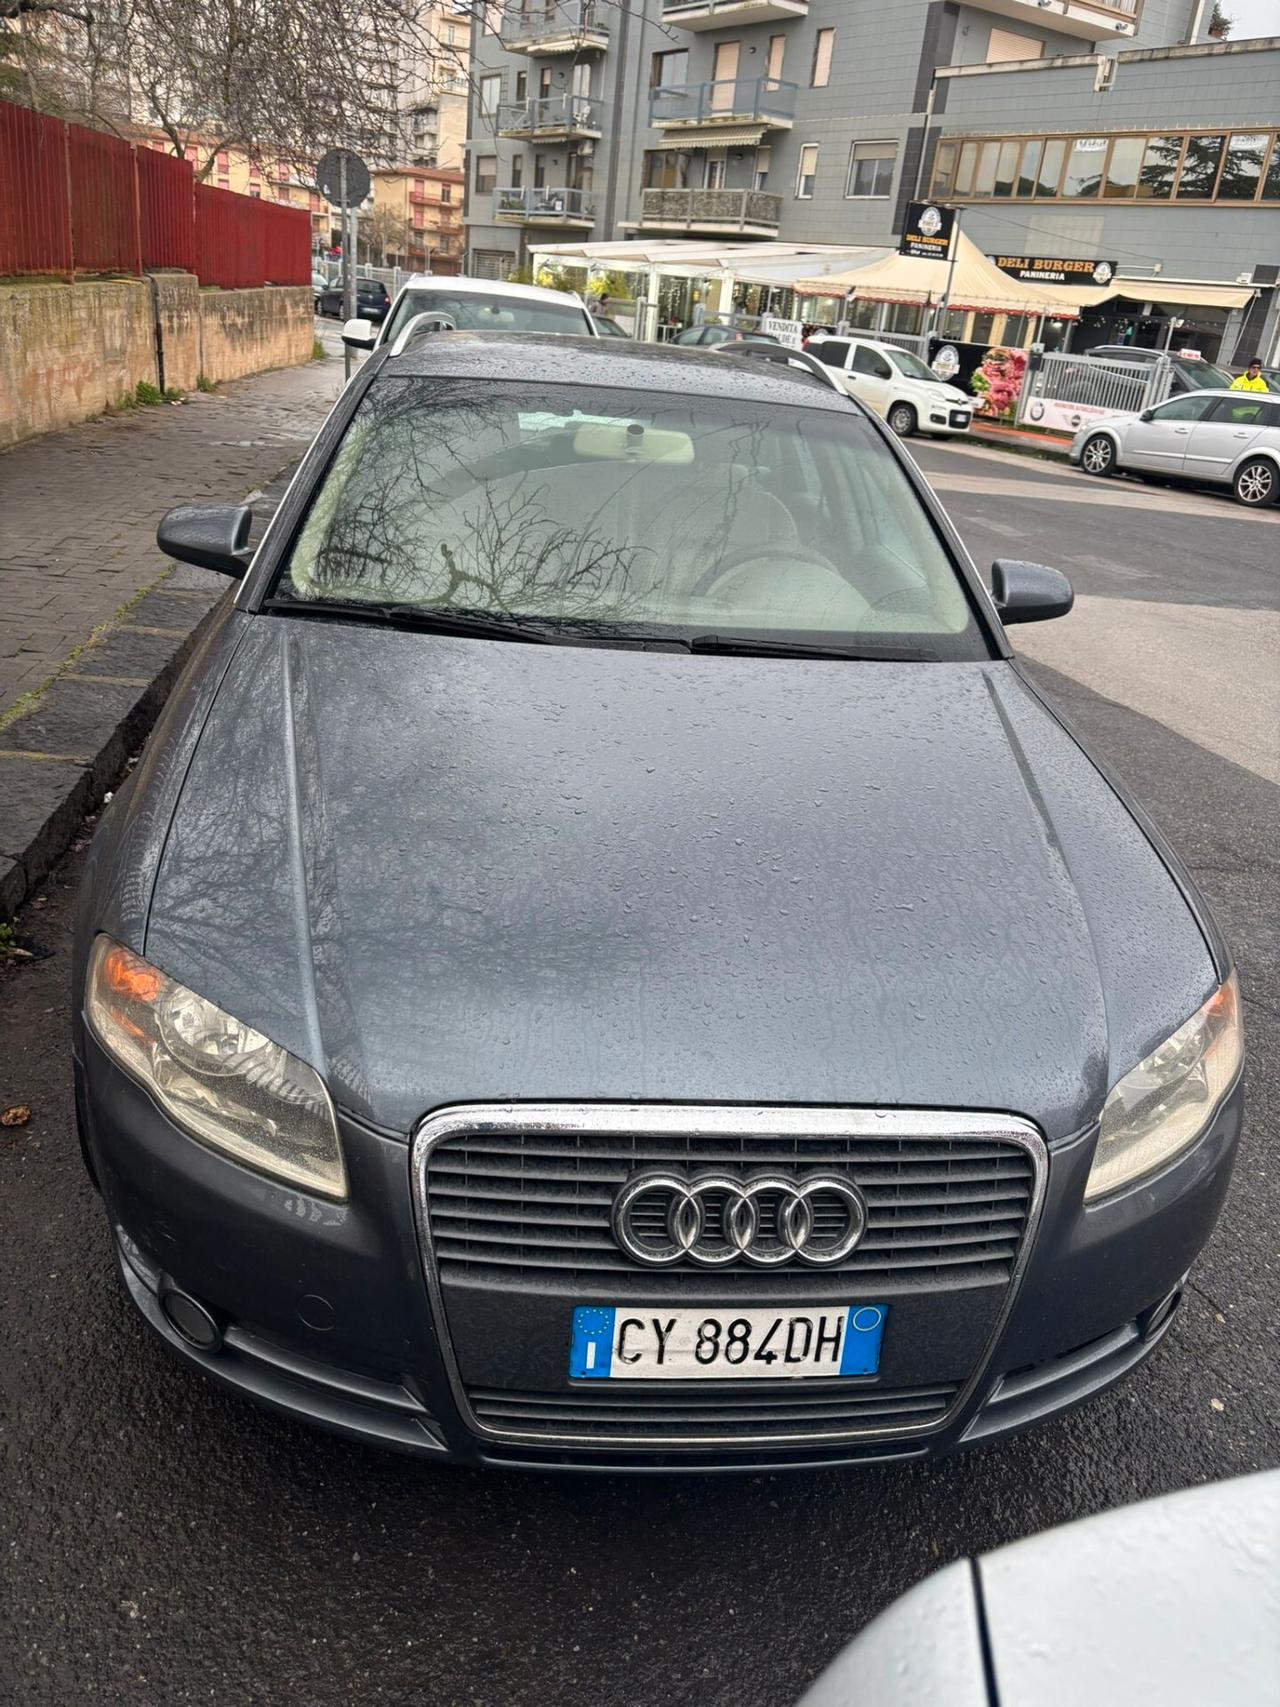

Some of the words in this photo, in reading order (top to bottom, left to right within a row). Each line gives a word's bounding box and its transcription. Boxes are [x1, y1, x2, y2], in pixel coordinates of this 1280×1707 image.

[997, 257, 1030, 269] DELI
[1033, 259, 1096, 273] BURGER
[1019, 270, 1066, 281] PANINERIA
[616, 1317, 677, 1364] CY
[694, 1315, 845, 1365] 884DH
